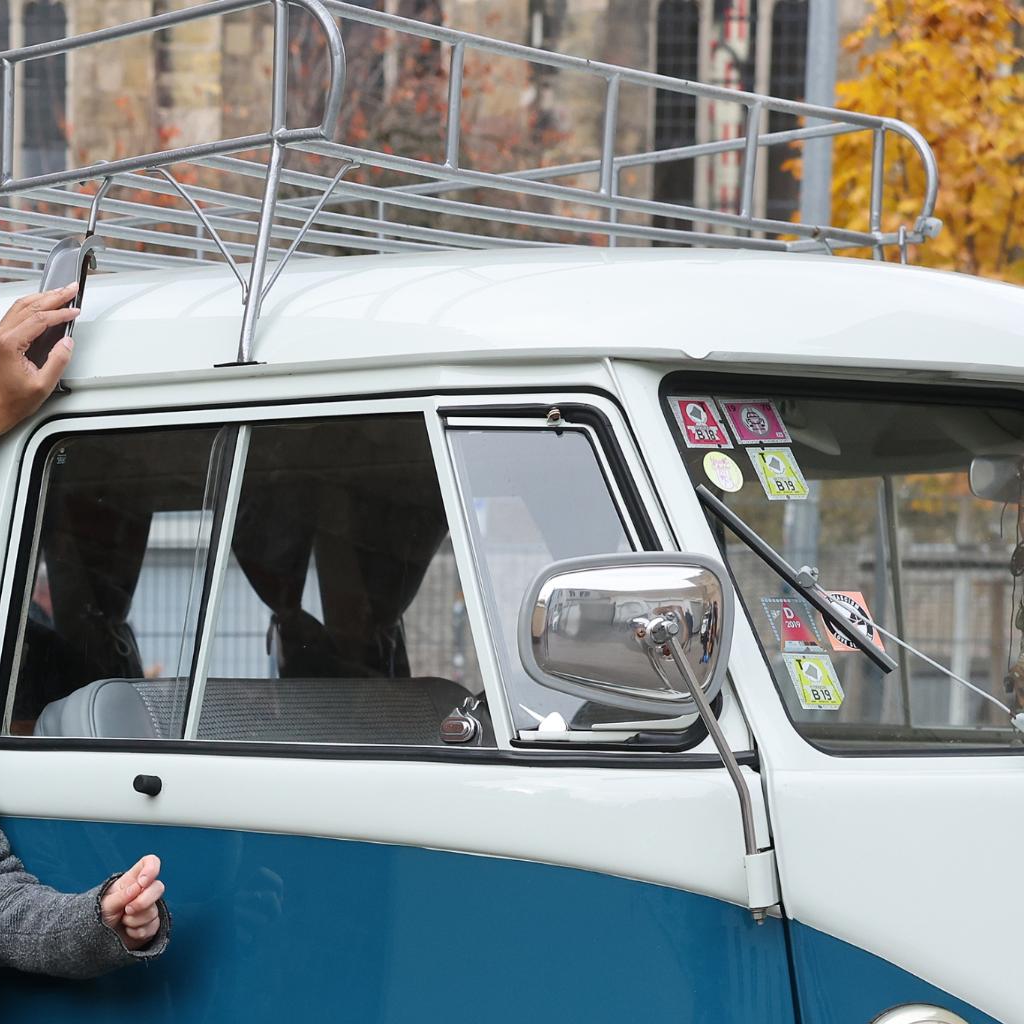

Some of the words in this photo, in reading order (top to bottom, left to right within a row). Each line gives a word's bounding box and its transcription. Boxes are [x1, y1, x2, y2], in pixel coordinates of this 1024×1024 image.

[759, 452, 766, 463] T
[783, 607, 794, 619] D
[785, 620, 801, 629] 2019
[834, 632, 847, 645] LOVE
[796, 659, 803, 670] T
